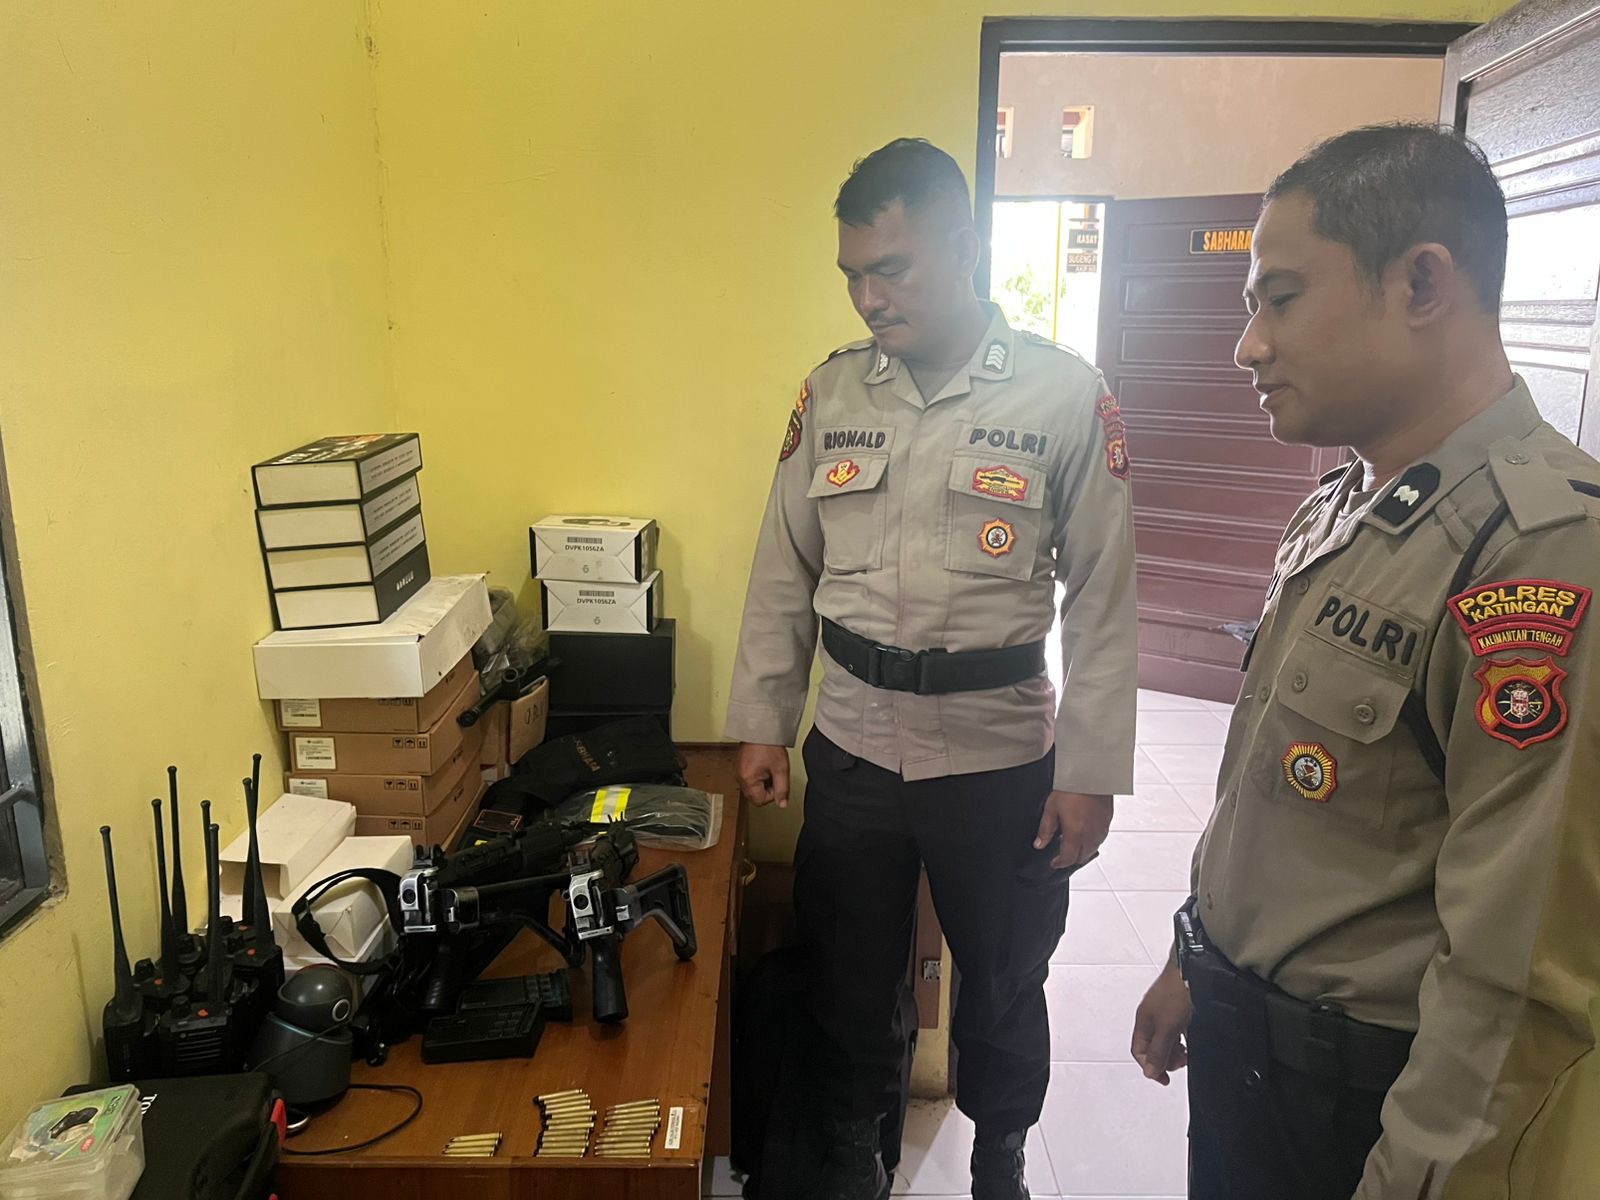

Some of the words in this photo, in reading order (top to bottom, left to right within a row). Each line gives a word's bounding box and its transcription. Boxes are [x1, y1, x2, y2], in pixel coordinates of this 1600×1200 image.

[1076, 234, 1098, 245] KASAT
[824, 430, 886, 451] RIONALD
[969, 428, 1047, 456] POLRI
[1458, 585, 1576, 616] POLRES
[1470, 601, 1564, 623] KATINGAN
[1314, 595, 1417, 666] POLRI
[1477, 629, 1527, 649] KALIMANTAN
[1528, 629, 1563, 647] TENGAH
